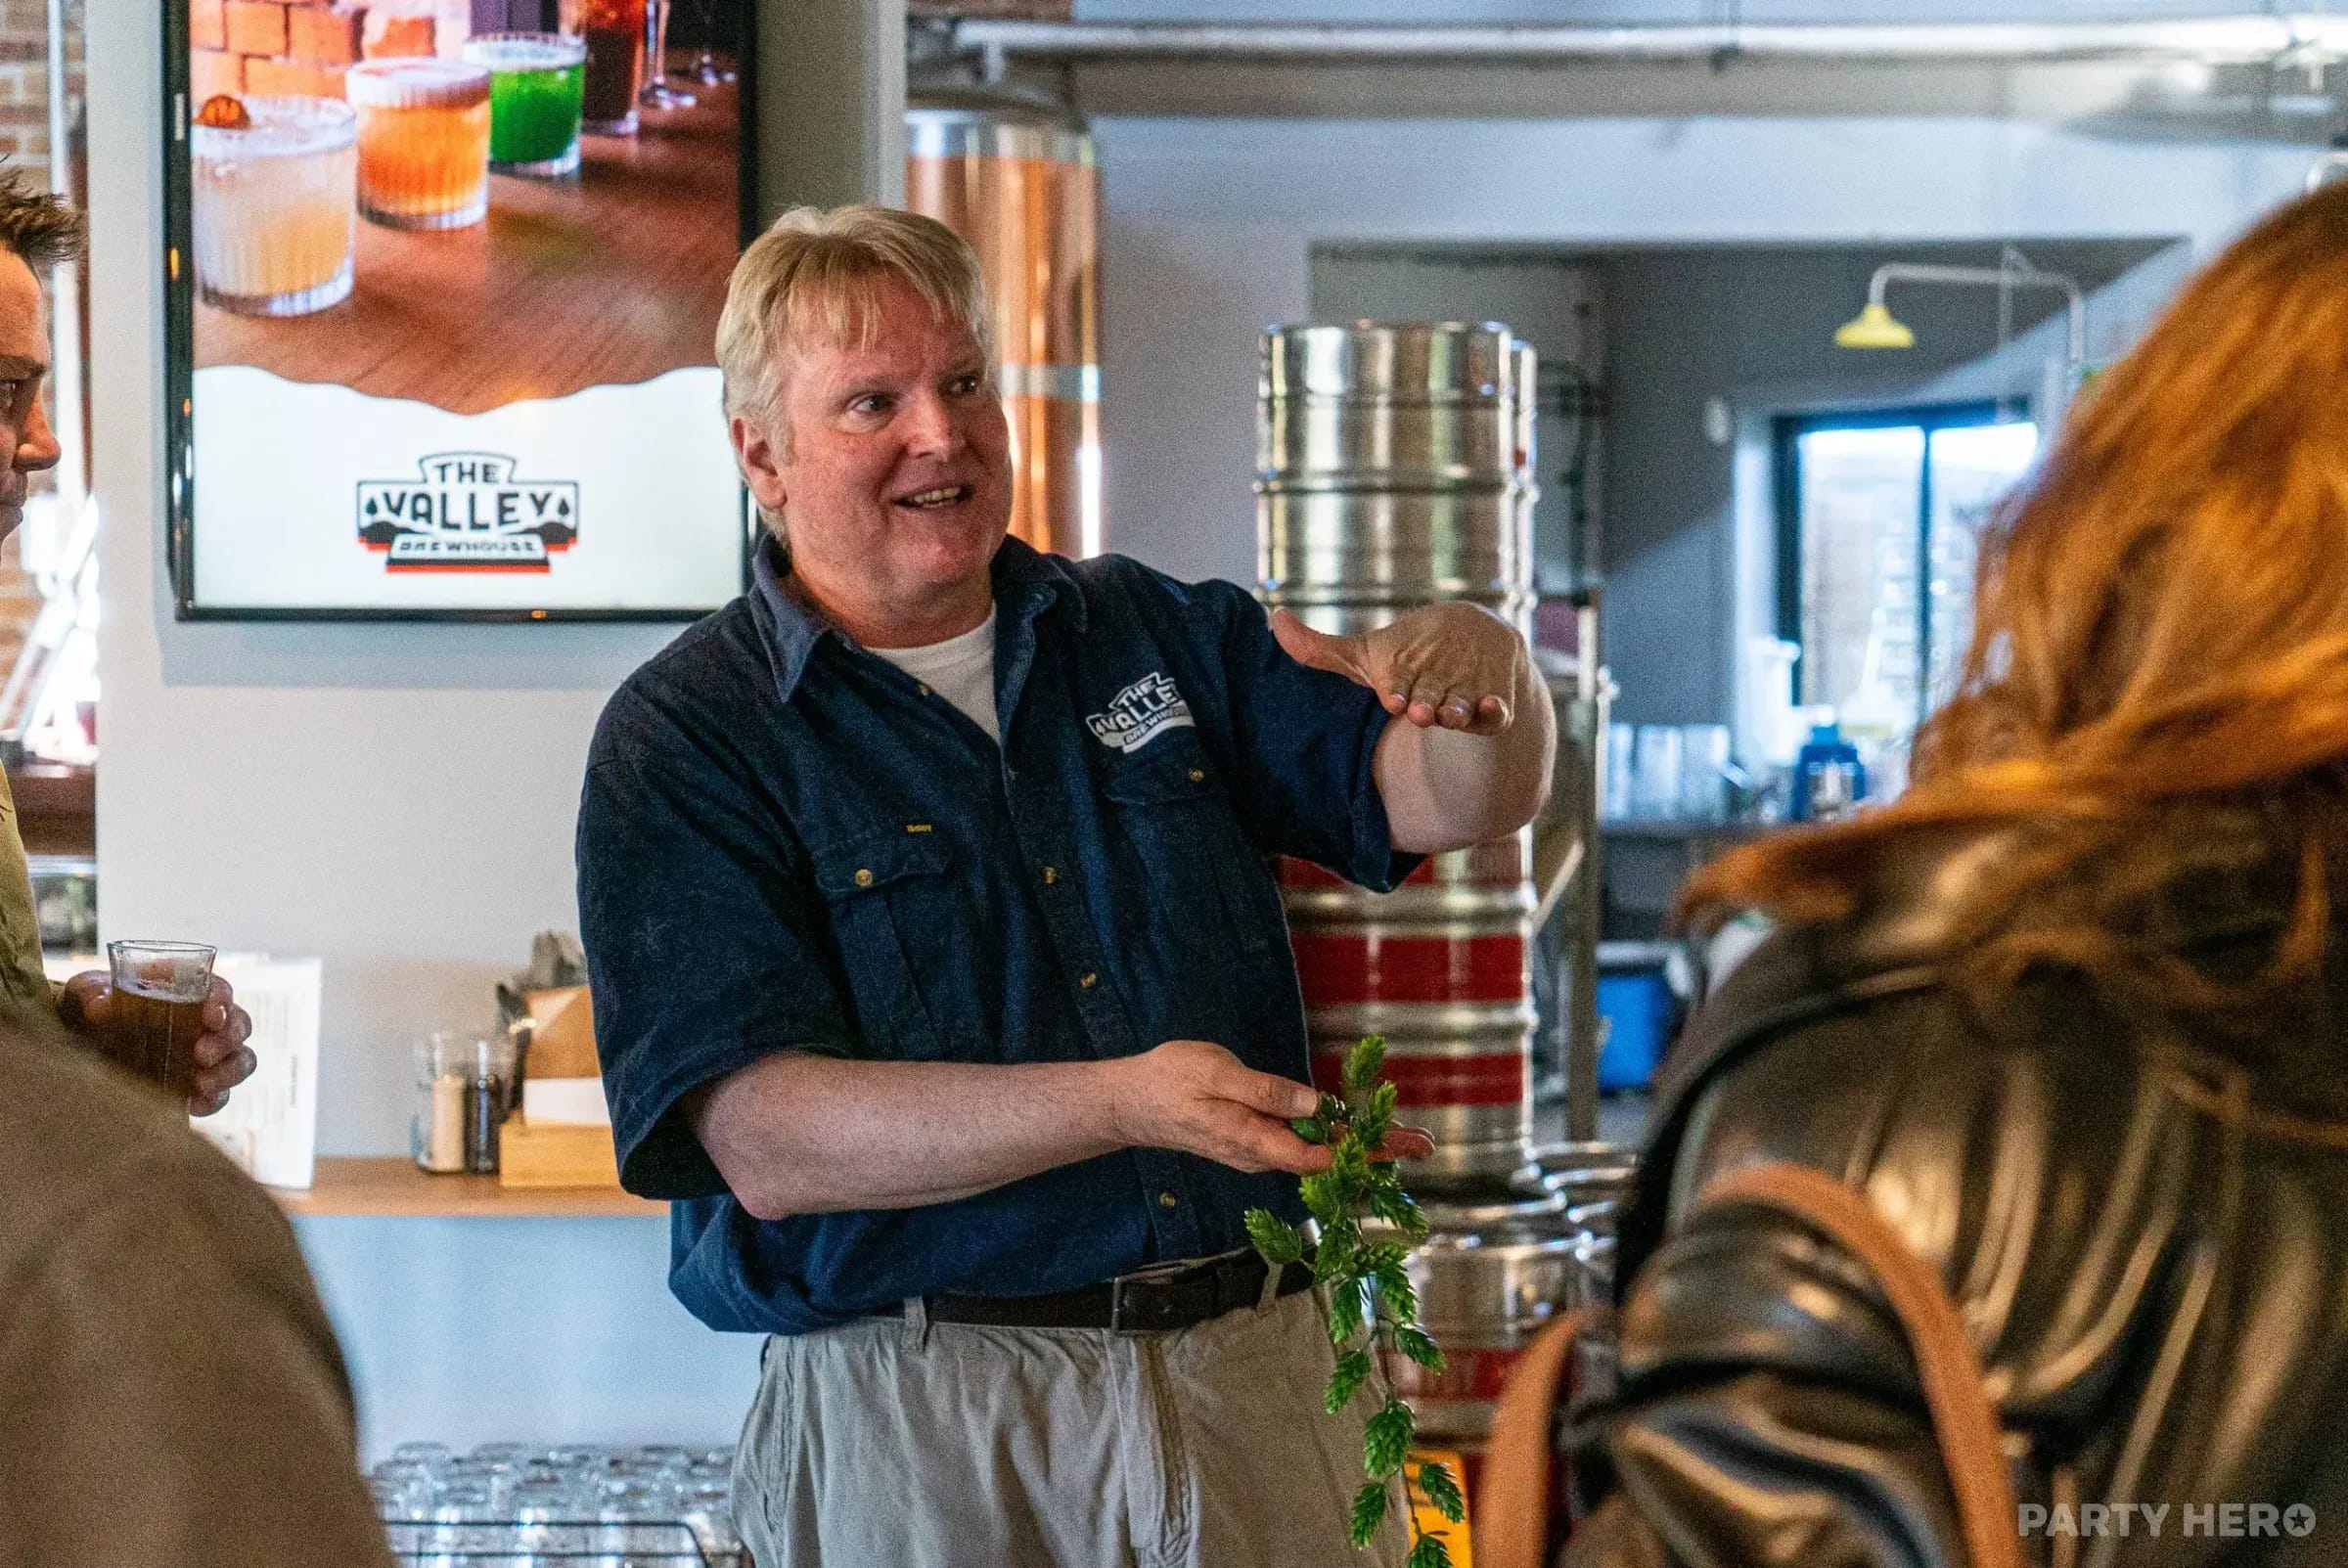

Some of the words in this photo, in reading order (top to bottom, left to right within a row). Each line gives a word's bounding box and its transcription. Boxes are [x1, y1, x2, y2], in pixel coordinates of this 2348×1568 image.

[434, 462, 499, 483] THE
[383, 491, 553, 531] VALLEY
[1101, 685, 1179, 730] VALLE
[1117, 680, 1156, 707] THE
